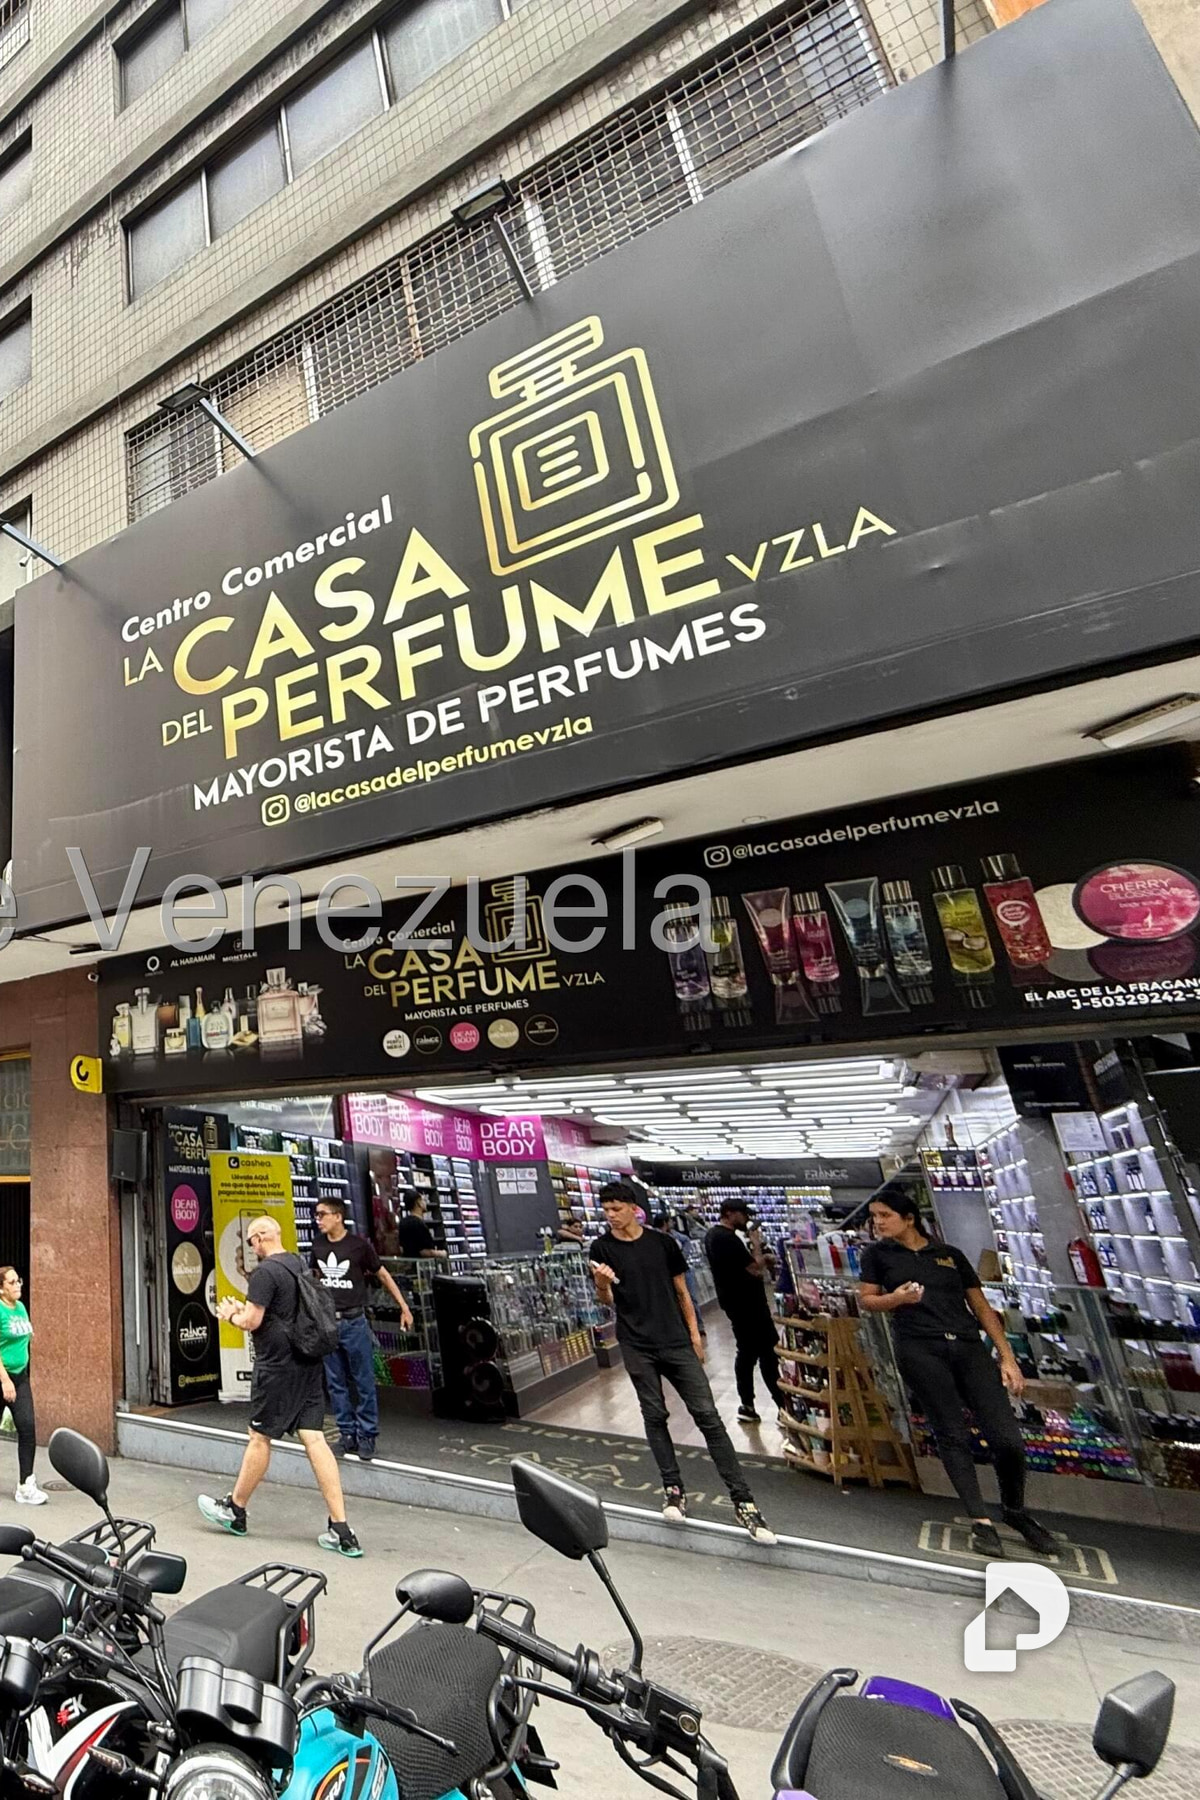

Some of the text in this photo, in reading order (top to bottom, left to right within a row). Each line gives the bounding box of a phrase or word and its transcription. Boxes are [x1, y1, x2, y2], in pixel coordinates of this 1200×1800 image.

[121, 494, 393, 643] Centro Comercial
[123, 527, 471, 696] LA CASA
[161, 506, 897, 760] DEL PERFUME VZLA
[193, 602, 766, 811] MAYORISTA DE PERFUMES
[293, 714, 594, 814] @lacasadelperfumevzla
[731, 800, 1000, 861] @lacasadelperfumevzla
[1100, 878, 1171, 893] CHERRY
[387, 920, 456, 943] Comercial
[222, 952, 258, 963] MONTALE
[344, 935, 485, 980] LA CASA
[364, 959, 606, 1008] DEL PERFUME VZLA
[1024, 977, 1200, 1002] EL ABC DE LA FRAGAN
[404, 998, 530, 1022] MAYORISTA DE PERFUMES
[355, 1115, 385, 1137] BODY
[389, 1121, 412, 1143] BODY
[453, 1117, 472, 1135] DEAR
[480, 1121, 535, 1138] DEAR
[174, 1131, 204, 1148] CASA
[424, 1128, 443, 1148] BODY
[456, 1134, 473, 1153] BODY
[482, 1139, 536, 1157] BODY
[175, 1199, 196, 1209] DEAR
[175, 1210, 196, 1220] BODY
